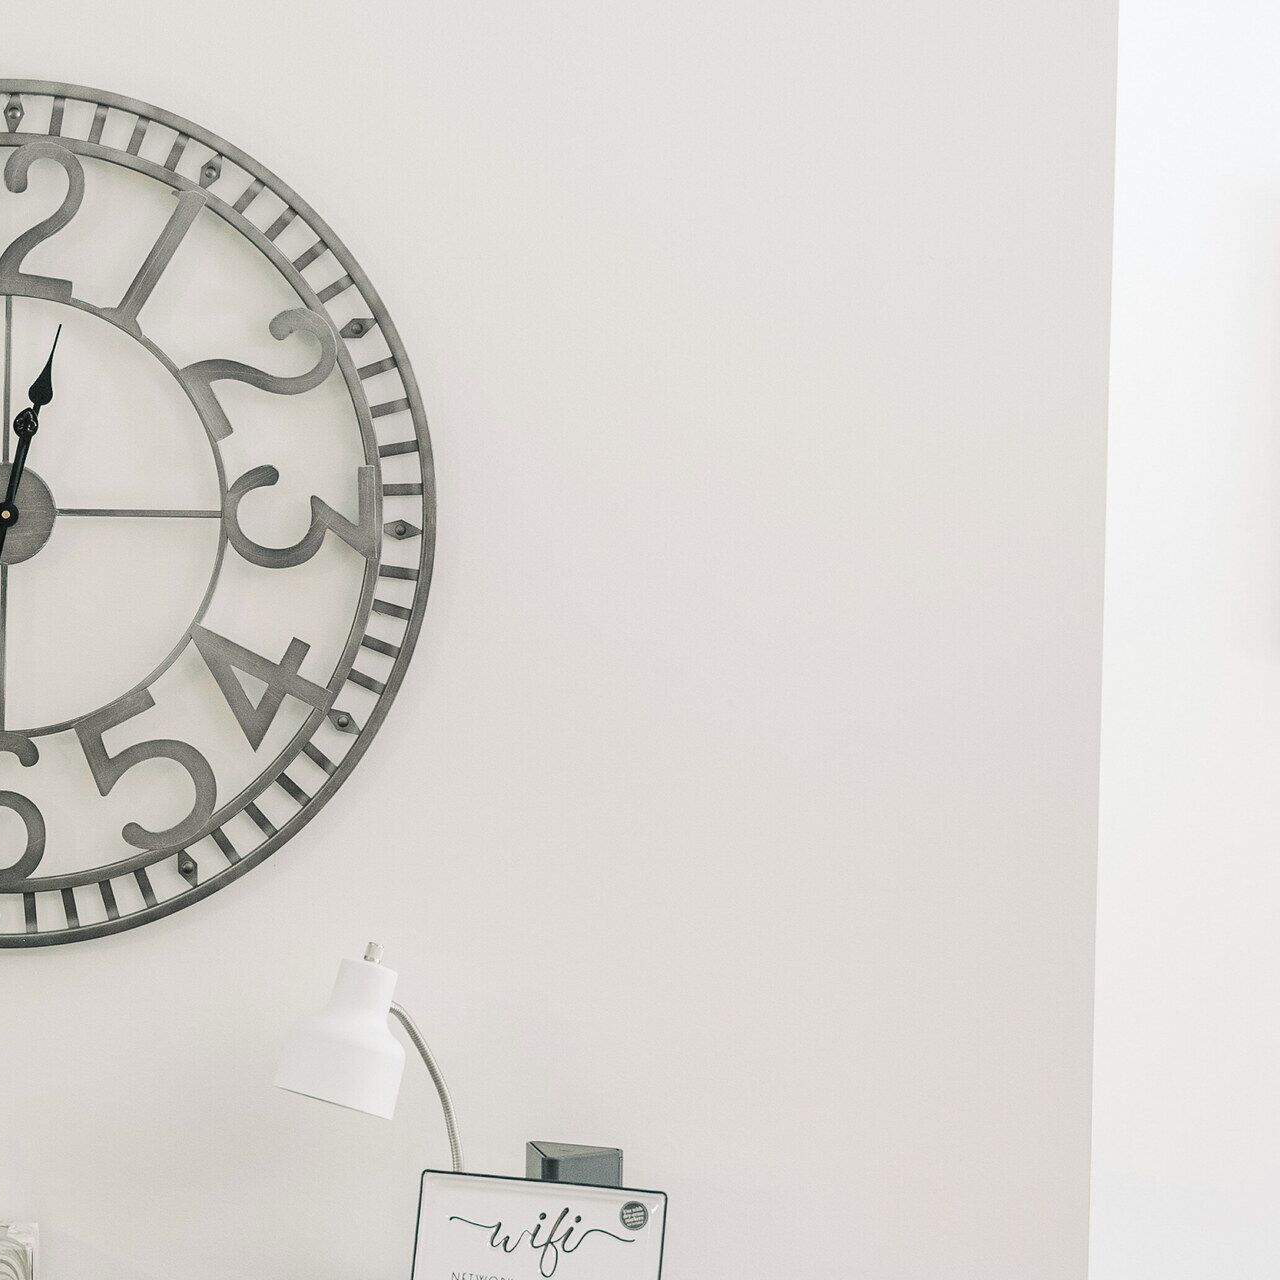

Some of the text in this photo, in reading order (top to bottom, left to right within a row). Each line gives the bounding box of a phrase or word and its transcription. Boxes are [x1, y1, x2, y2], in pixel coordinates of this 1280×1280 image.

[104, 190, 207, 336] 1
[179, 308, 338, 440] 2
[221, 464, 381, 568] 3
[191, 623, 336, 752] 4
[73, 688, 218, 850] 5
[449, 1207, 635, 1278] wifi
